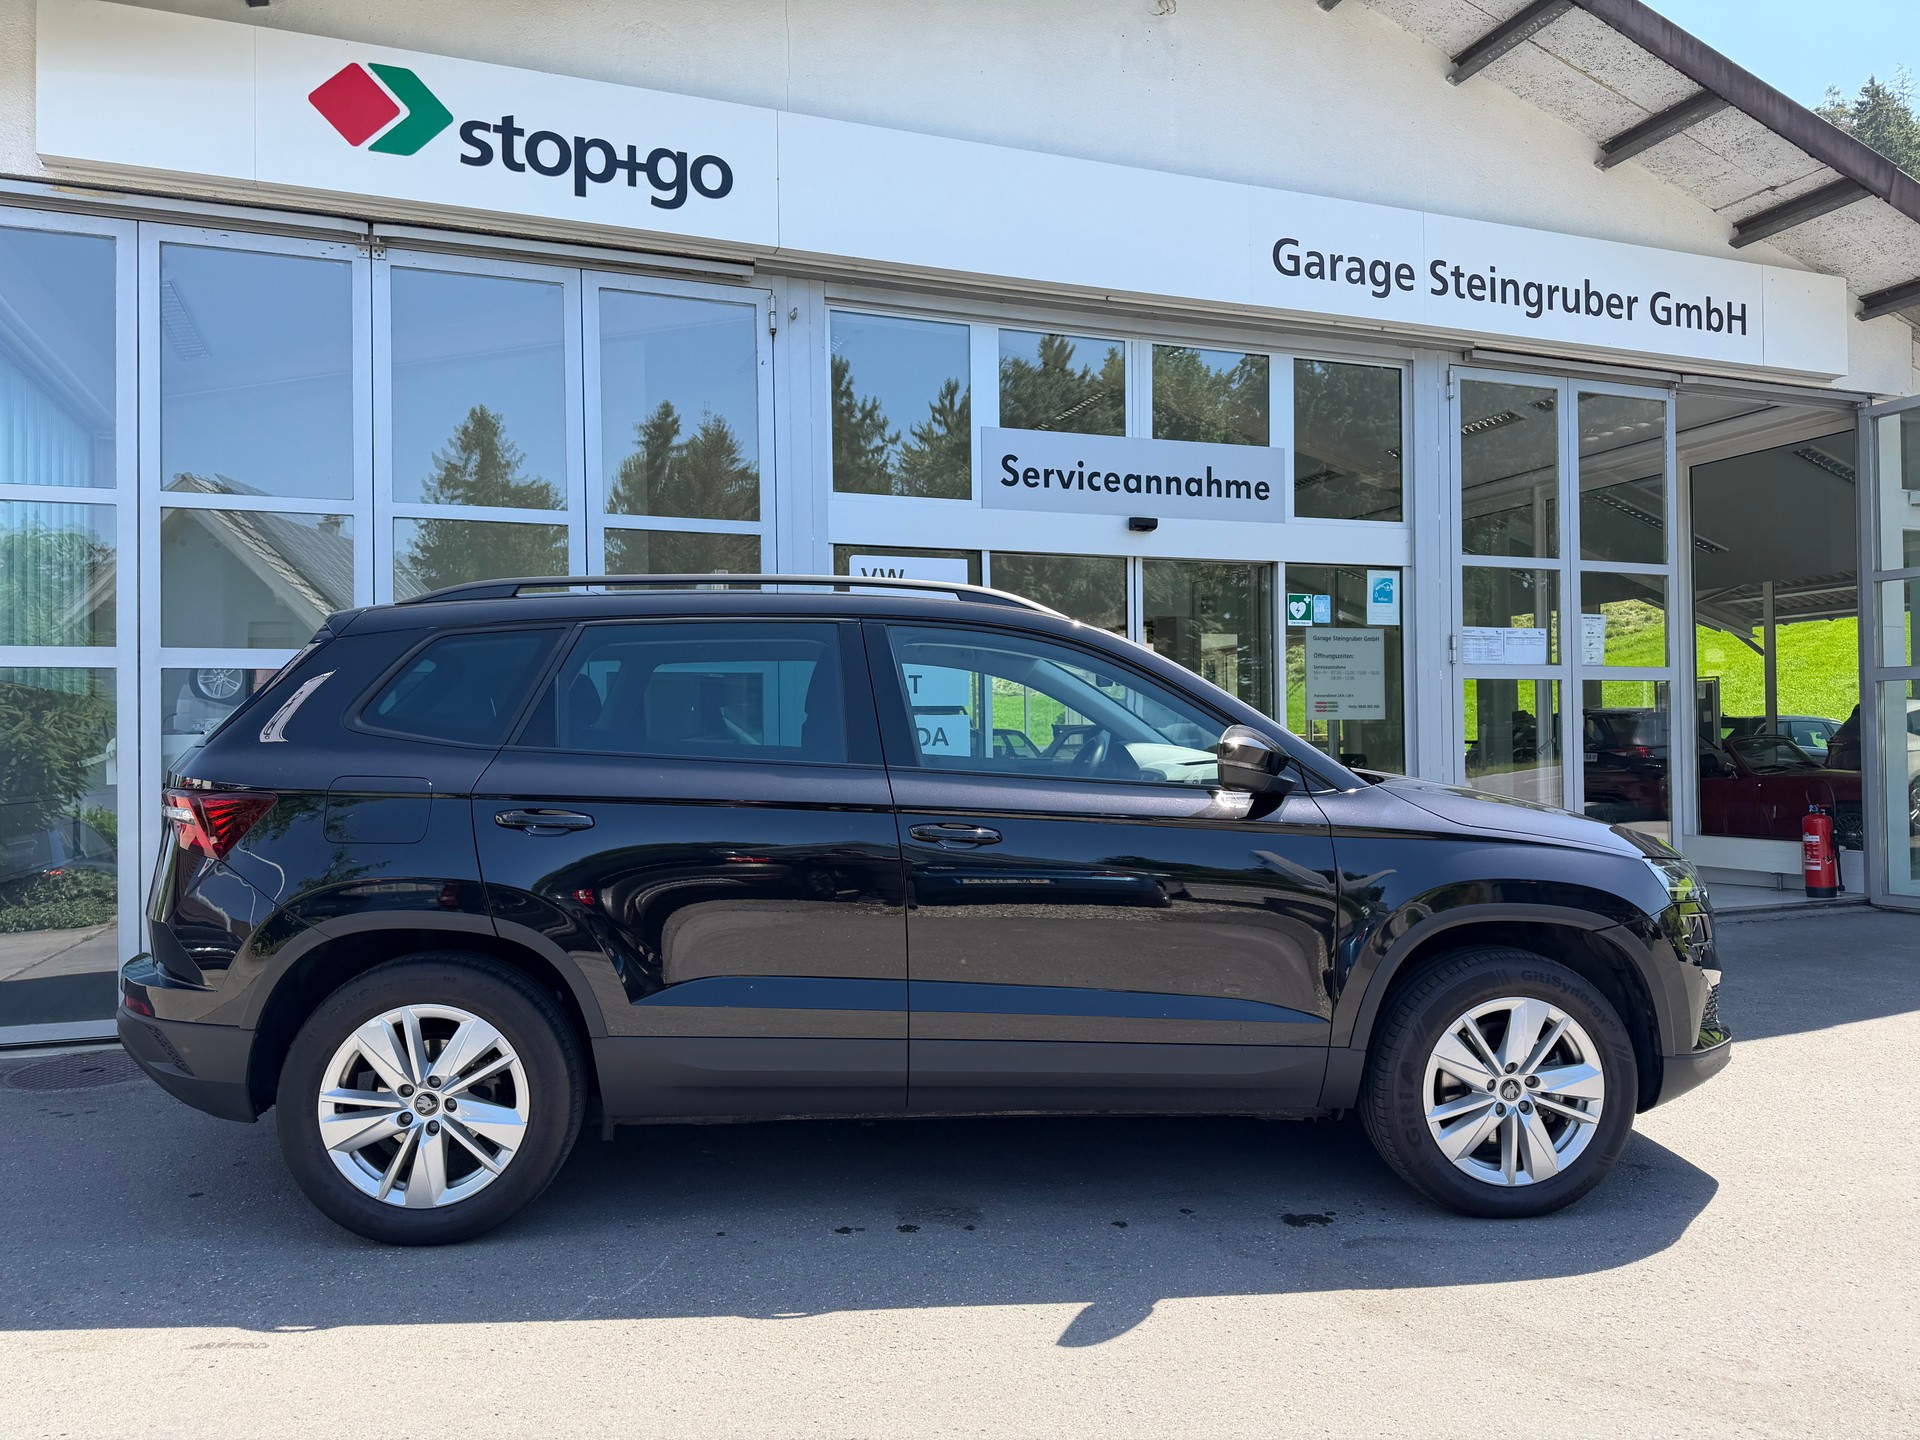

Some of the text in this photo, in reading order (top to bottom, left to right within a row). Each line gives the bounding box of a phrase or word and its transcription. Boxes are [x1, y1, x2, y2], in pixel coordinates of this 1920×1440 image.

[459, 115, 733, 210] stop+go
[1272, 238, 1747, 335] Garage Steingruber GmbH
[1000, 454, 1270, 500] Serviceannahme
[1520, 970, 1609, 1025] GitiSynergy
